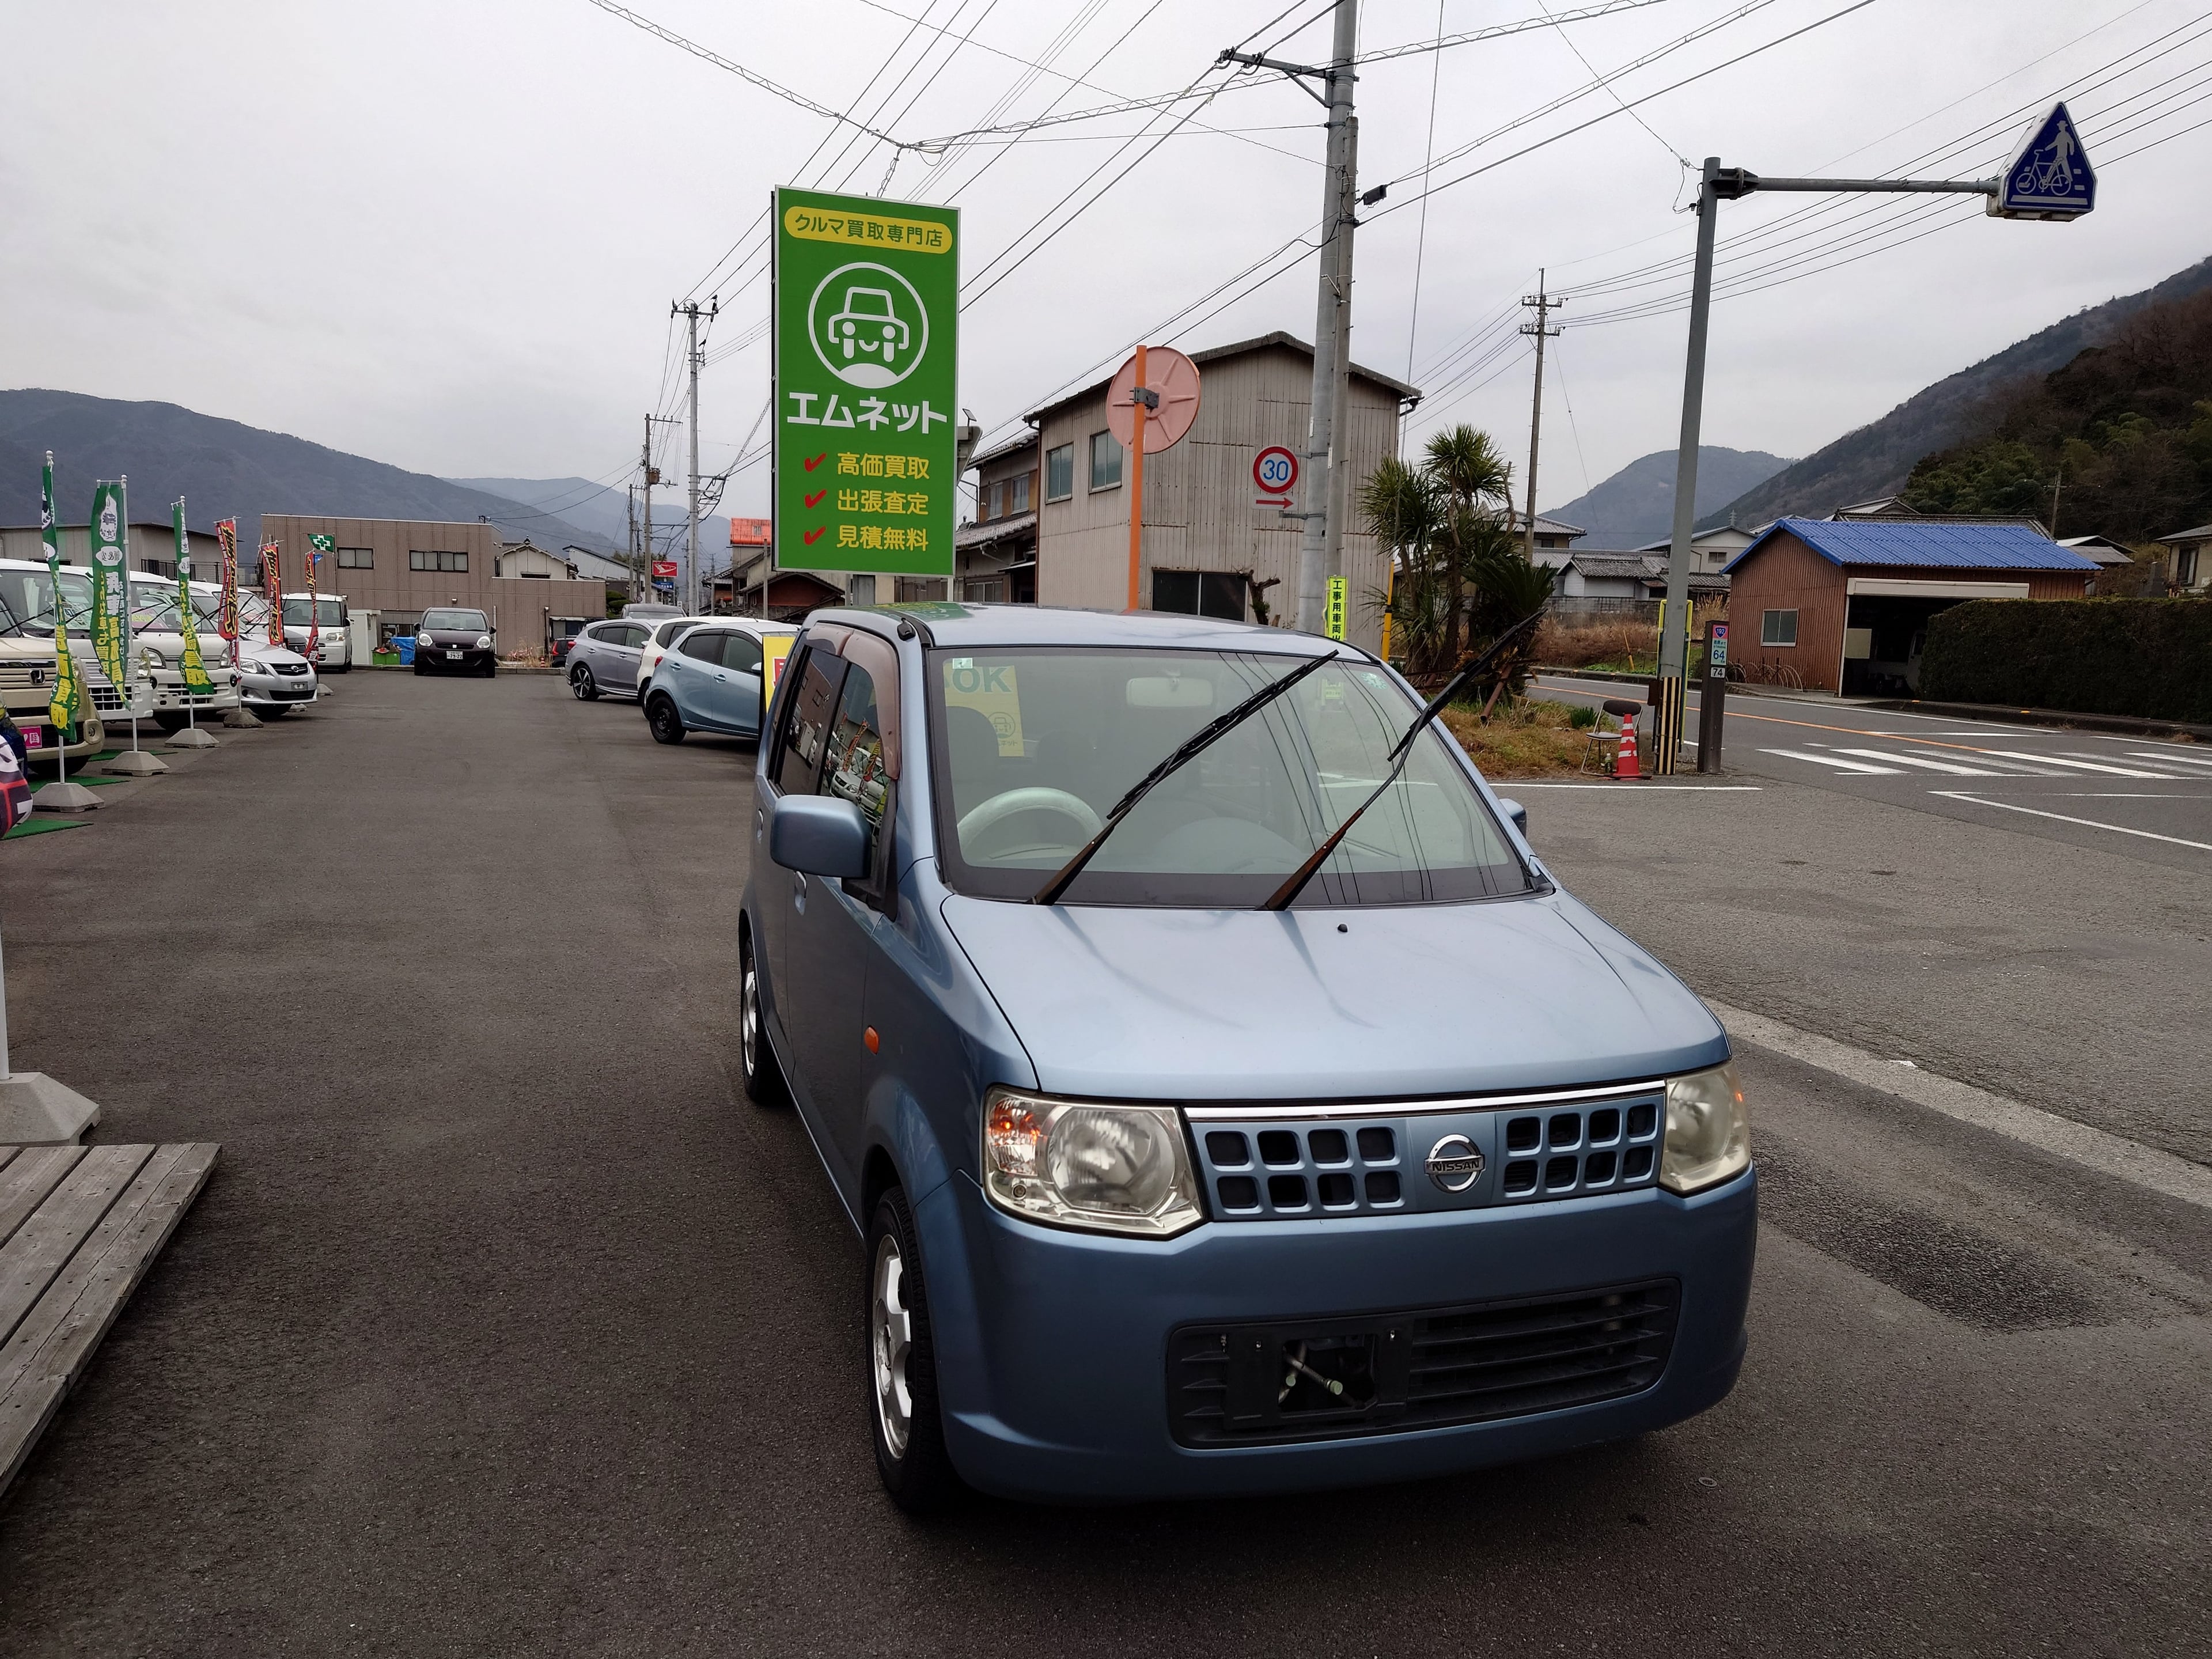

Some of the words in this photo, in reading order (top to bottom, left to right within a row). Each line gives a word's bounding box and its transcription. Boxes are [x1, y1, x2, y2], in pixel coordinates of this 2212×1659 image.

[795, 214, 943, 247] クルマ買取専門店
[787, 392, 948, 434] エムネット
[837, 452, 930, 479] 高価買取
[1263, 459, 1289, 482] 30
[837, 488, 929, 515] 出張査定
[836, 525, 929, 551] 見積無料
[1713, 650, 1725, 660] 64
[952, 666, 1013, 692] OK
[1713, 668, 1723, 677] 74
[1432, 1160, 1480, 1172] NISSAN
